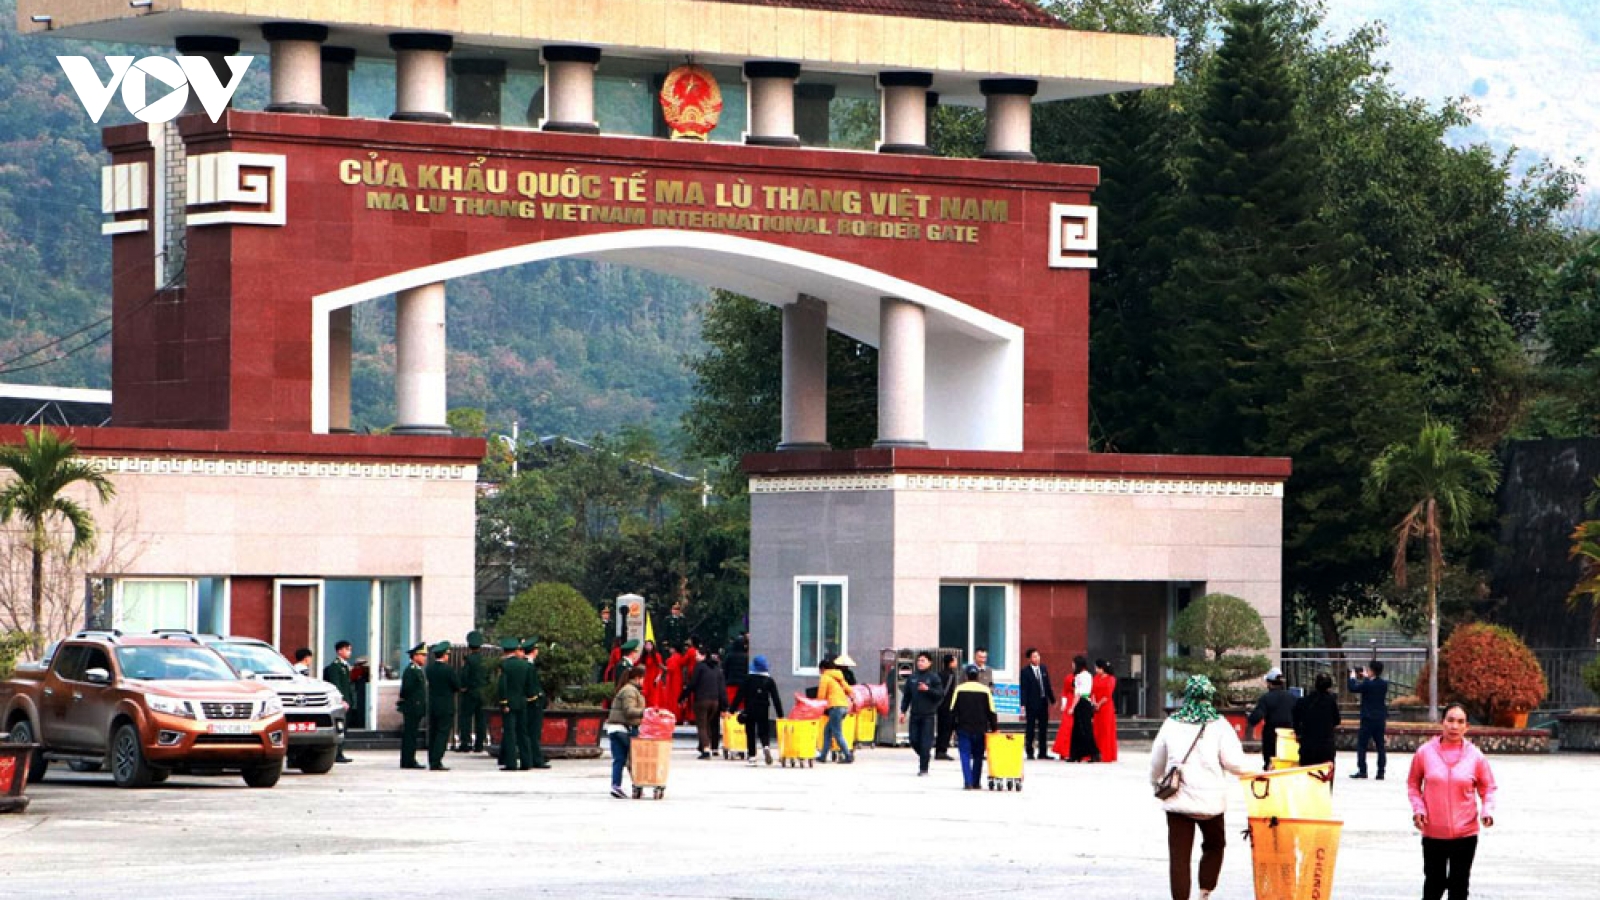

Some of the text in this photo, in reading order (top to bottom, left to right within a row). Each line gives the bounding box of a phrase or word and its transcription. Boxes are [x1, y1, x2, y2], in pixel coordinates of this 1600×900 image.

[339, 151, 408, 187] CỬA
[418, 156, 507, 193] KHẨU
[611, 170, 647, 202] TẾ
[655, 180, 705, 207] MA
[715, 178, 753, 208] LÙ
[762, 184, 862, 214] THÀNG
[870, 188, 931, 221] VIỆT
[940, 196, 1009, 223] NAM
[366, 191, 979, 243] MA LU THANG VIETNAM INTERNATIONAL BORDER GATE
